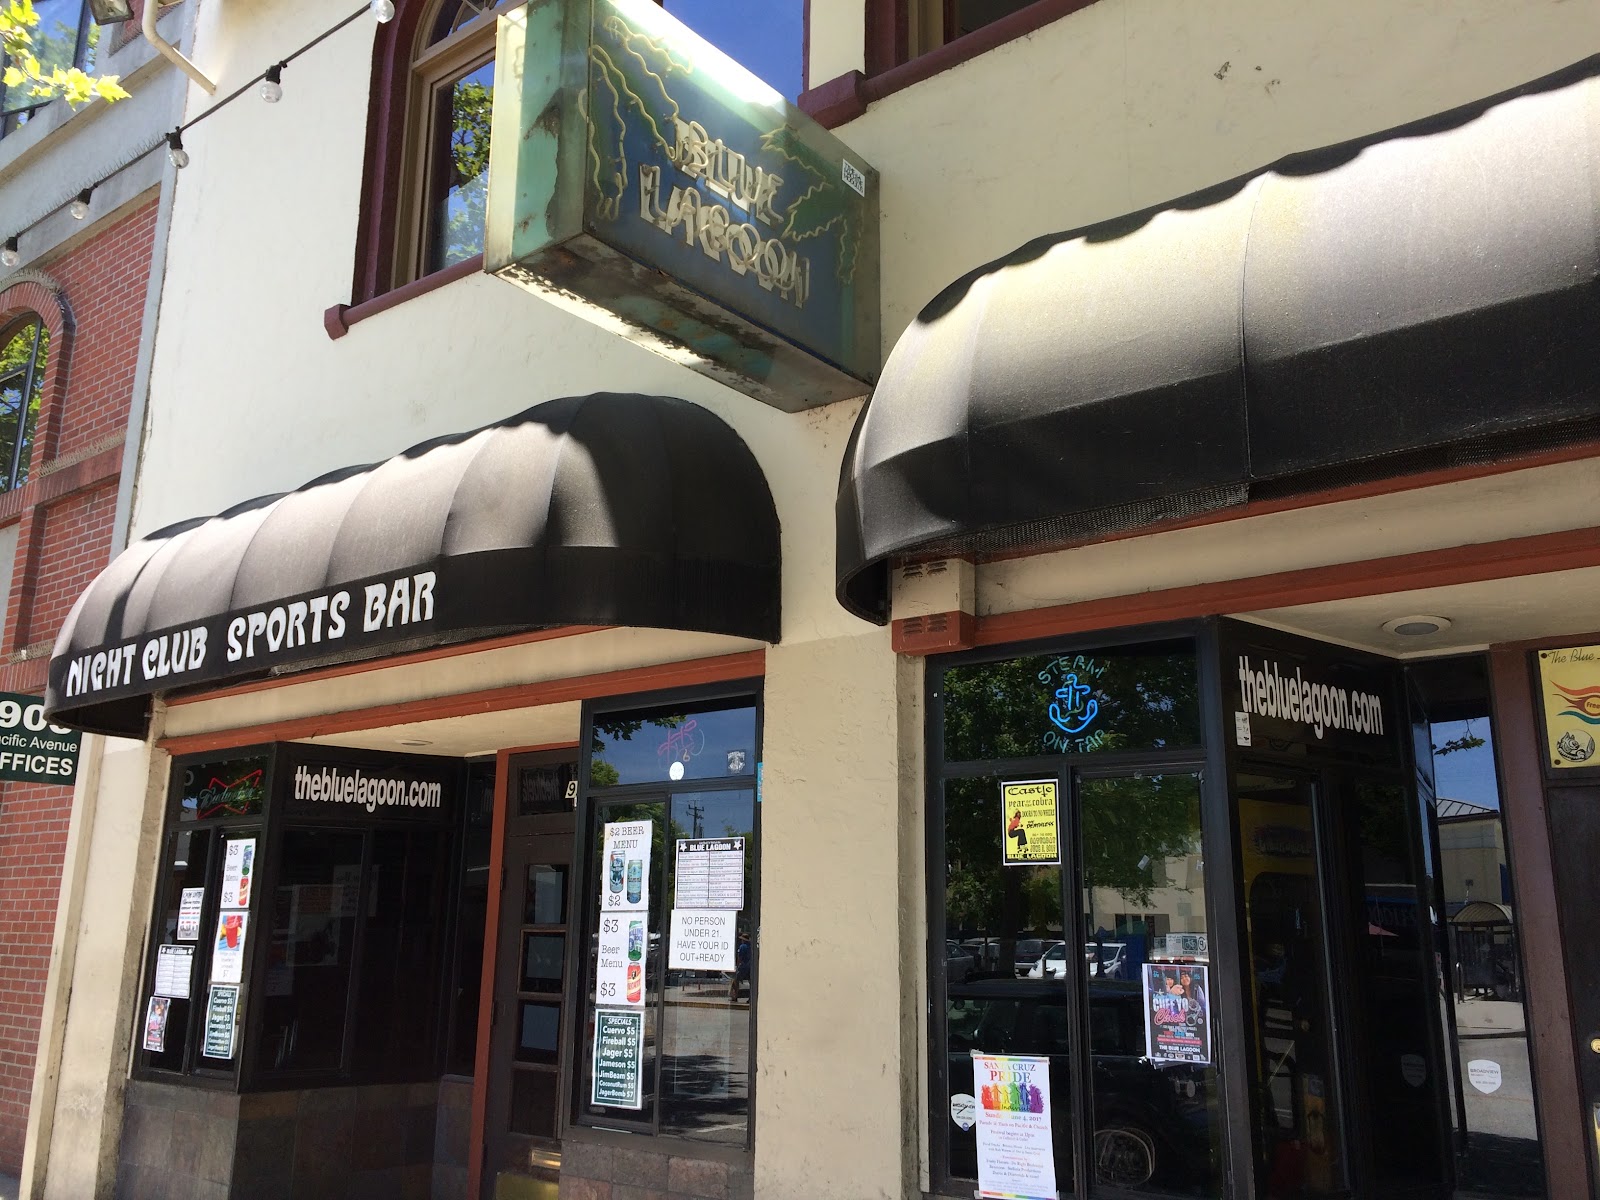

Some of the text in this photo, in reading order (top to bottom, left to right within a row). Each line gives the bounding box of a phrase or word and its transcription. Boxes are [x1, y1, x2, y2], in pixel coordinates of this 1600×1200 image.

[676, 118, 785, 226] BLUE
[640, 164, 810, 309] LAGOON
[66, 571, 437, 698] NIGHT CLUB SPORTS BAR
[1548, 648, 1595, 664] The Blue
[1238, 655, 1384, 740] thebluelagoon.com
[0, 734, 77, 753] cific Avenue
[1075, 729, 1105, 753] TAP
[295, 765, 441, 813] thebluelagoon.com
[1008, 785, 1053, 797] Castle
[609, 825, 645, 837] $2 BEER
[613, 839, 638, 850] MENU
[706, 843, 731, 851] LAGOON
[608, 894, 621, 907] $2
[603, 918, 619, 934] $3
[682, 916, 726, 926] NO PERSON
[684, 929, 710, 938] UNDER
[601, 944, 621, 954] Beer
[677, 940, 729, 950] HAVE YOUR ID
[600, 958, 623, 968] Menu
[600, 982, 616, 998] $3
[608, 1017, 632, 1026] SPECIALS
[602, 1026, 635, 1036] Cuervo $5
[602, 1037, 636, 1047] Fireball $5
[602, 1047, 633, 1059] Jager $5
[599, 1059, 635, 1069] Jameson $5
[1012, 1063, 1037, 1072] CRUZ
[626, 1071, 635, 1081] $5
[990, 1070, 1031, 1083] PRIDE
